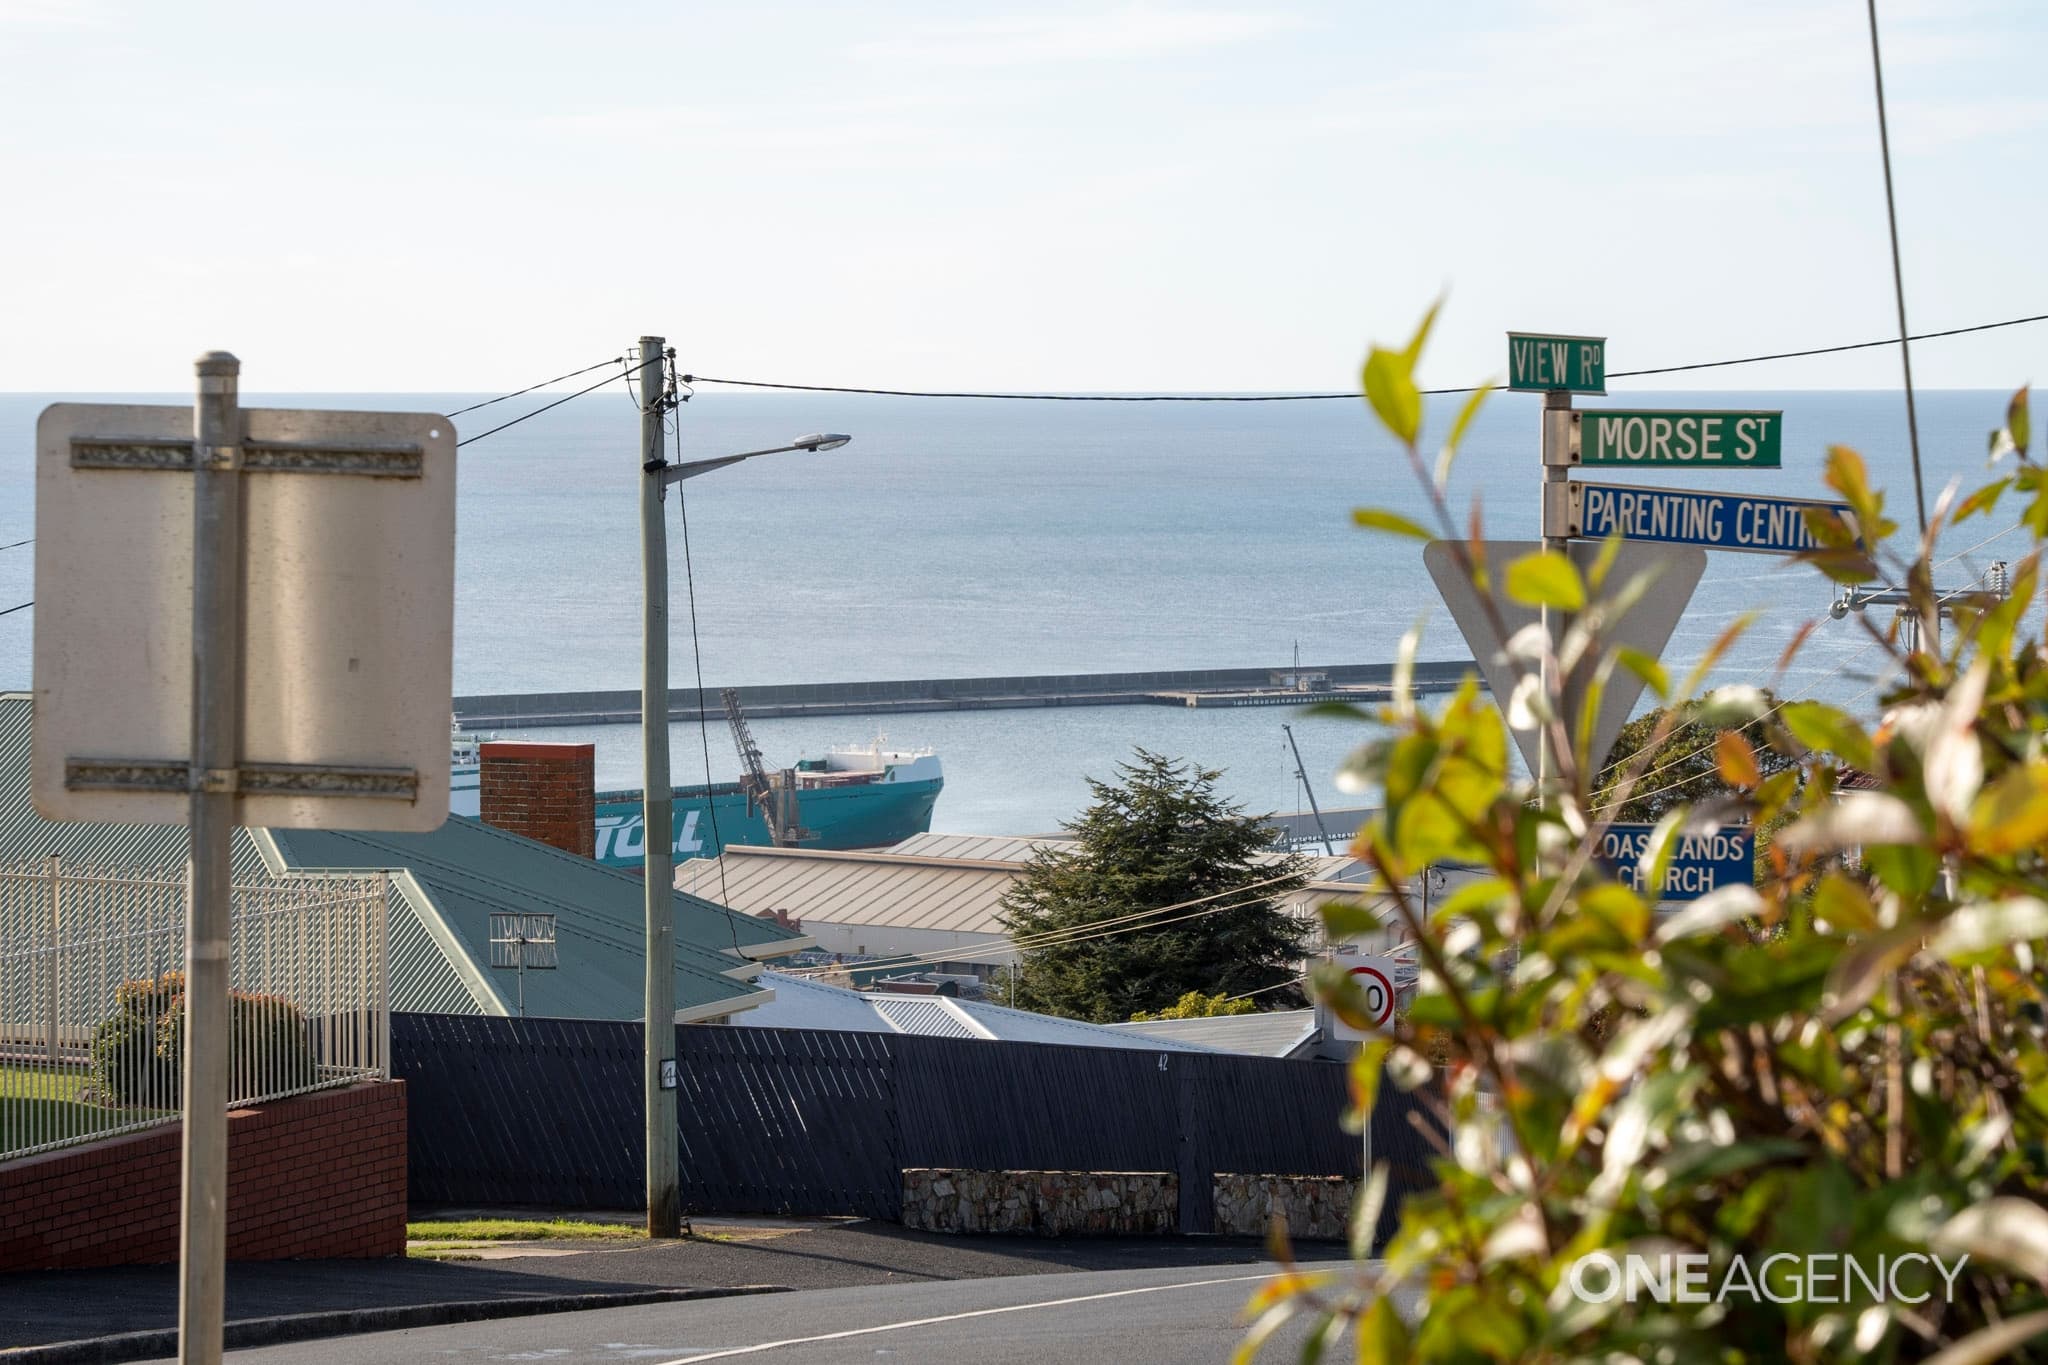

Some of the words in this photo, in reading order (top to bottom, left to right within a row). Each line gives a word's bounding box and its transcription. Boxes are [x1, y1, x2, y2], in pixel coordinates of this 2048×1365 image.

[1513, 341, 1569, 385] VIEW
[1580, 345, 1600, 385] RD
[1598, 417, 1723, 460] MORSE
[1735, 417, 1771, 461] ST
[1586, 490, 1724, 542] PARENTING
[1617, 865, 1714, 892] CHRCH
[1158, 1053, 1168, 1071] 42
